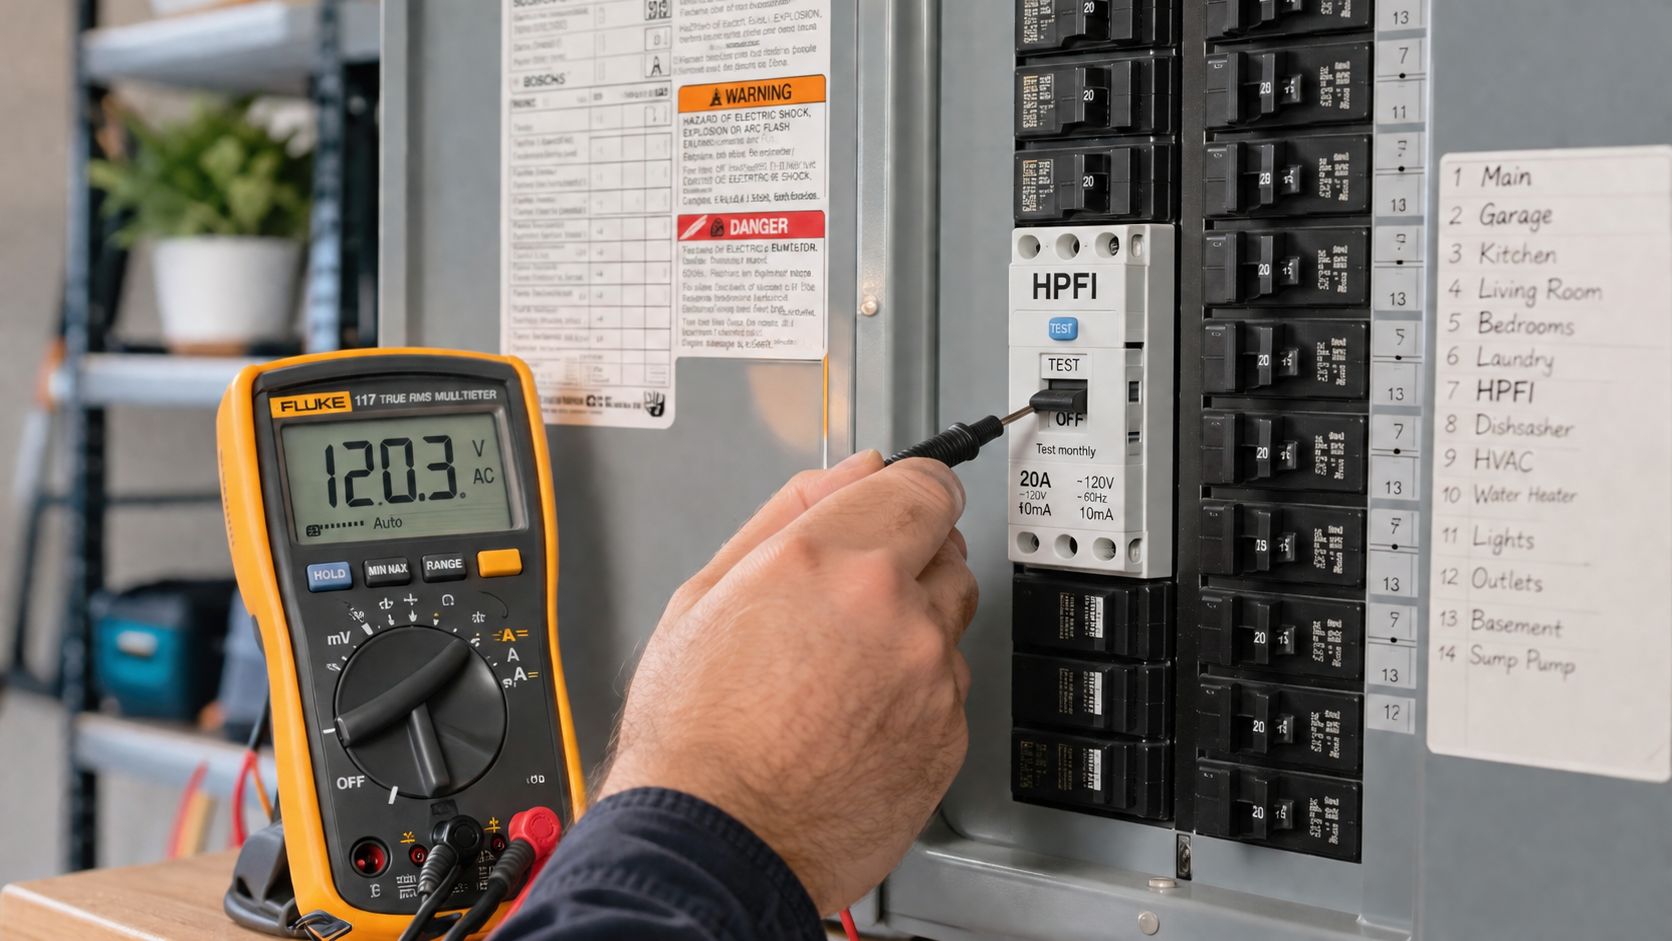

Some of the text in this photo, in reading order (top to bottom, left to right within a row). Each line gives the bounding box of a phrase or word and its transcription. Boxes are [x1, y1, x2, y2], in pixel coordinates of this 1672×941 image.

[1084, 2, 1094, 13] 20
[1392, 11, 1409, 25] 13
[1399, 47, 1408, 64] 7
[726, 83, 792, 104] WARNING
[1083, 90, 1094, 101] 20
[683, 115, 718, 126] HAZARD
[721, 114, 732, 123] OF
[735, 110, 776, 122] ELECTRIC
[1392, 105, 1407, 119] 11
[683, 124, 728, 137] EXPLOSION
[744, 124, 761, 134] ARC
[764, 122, 790, 132] FLASH
[1083, 176, 1094, 187] 20
[1454, 166, 1531, 187] 1 Main
[1391, 198, 1407, 212] 13
[1449, 203, 1553, 233] 2 Garage
[730, 218, 789, 235] DANGER
[1449, 243, 1557, 265] 3 Kitchen
[1258, 264, 1270, 275] 20
[1033, 273, 1097, 300] HPFI
[1449, 277, 1602, 308] 4 Living Room
[1390, 292, 1406, 306] 13
[1050, 323, 1073, 334] TEST
[1448, 311, 1575, 336] 5 Bedrooms
[1048, 358, 1080, 372] TEST
[1258, 355, 1269, 366] 20
[1447, 346, 1554, 377] 6 Laundry
[1388, 388, 1404, 401] 13
[1448, 379, 1535, 403] 7 HPFI
[281, 397, 346, 412] FLUKE
[355, 394, 376, 406] 117
[379, 393, 406, 404] TRUE
[409, 392, 432, 402] RMS
[1056, 411, 1084, 427] OFF
[1445, 414, 1457, 433] 8
[1394, 424, 1404, 439] 7
[472, 439, 485, 457] V
[1036, 443, 1096, 459] Test monthly
[1257, 447, 1268, 459] 20
[1444, 448, 1534, 472] 9 HVAC
[473, 467, 495, 484] AC
[1020, 470, 1051, 488] 20A
[1385, 481, 1402, 495] 13
[1442, 484, 1578, 504] 10 Water Heater
[1080, 507, 1114, 521] 10mA
[373, 517, 403, 530] Auto
[1442, 525, 1535, 555] 11 Lights
[369, 565, 387, 576] MIN
[426, 559, 463, 570] RANGE
[314, 568, 346, 580] HOLD
[1440, 566, 1543, 593] 12 Outlets
[1383, 577, 1400, 592] 13
[1440, 609, 1563, 637] 13 Basement
[327, 631, 351, 645] mV
[1254, 631, 1266, 644] 20
[507, 647, 520, 662] A
[1438, 644, 1576, 682] 14 Sump Pump
[1382, 669, 1398, 683] 13
[1385, 705, 1400, 720] 12
[1253, 720, 1264, 733] 20
[336, 776, 365, 790] OFF
[1252, 805, 1264, 819] 20
